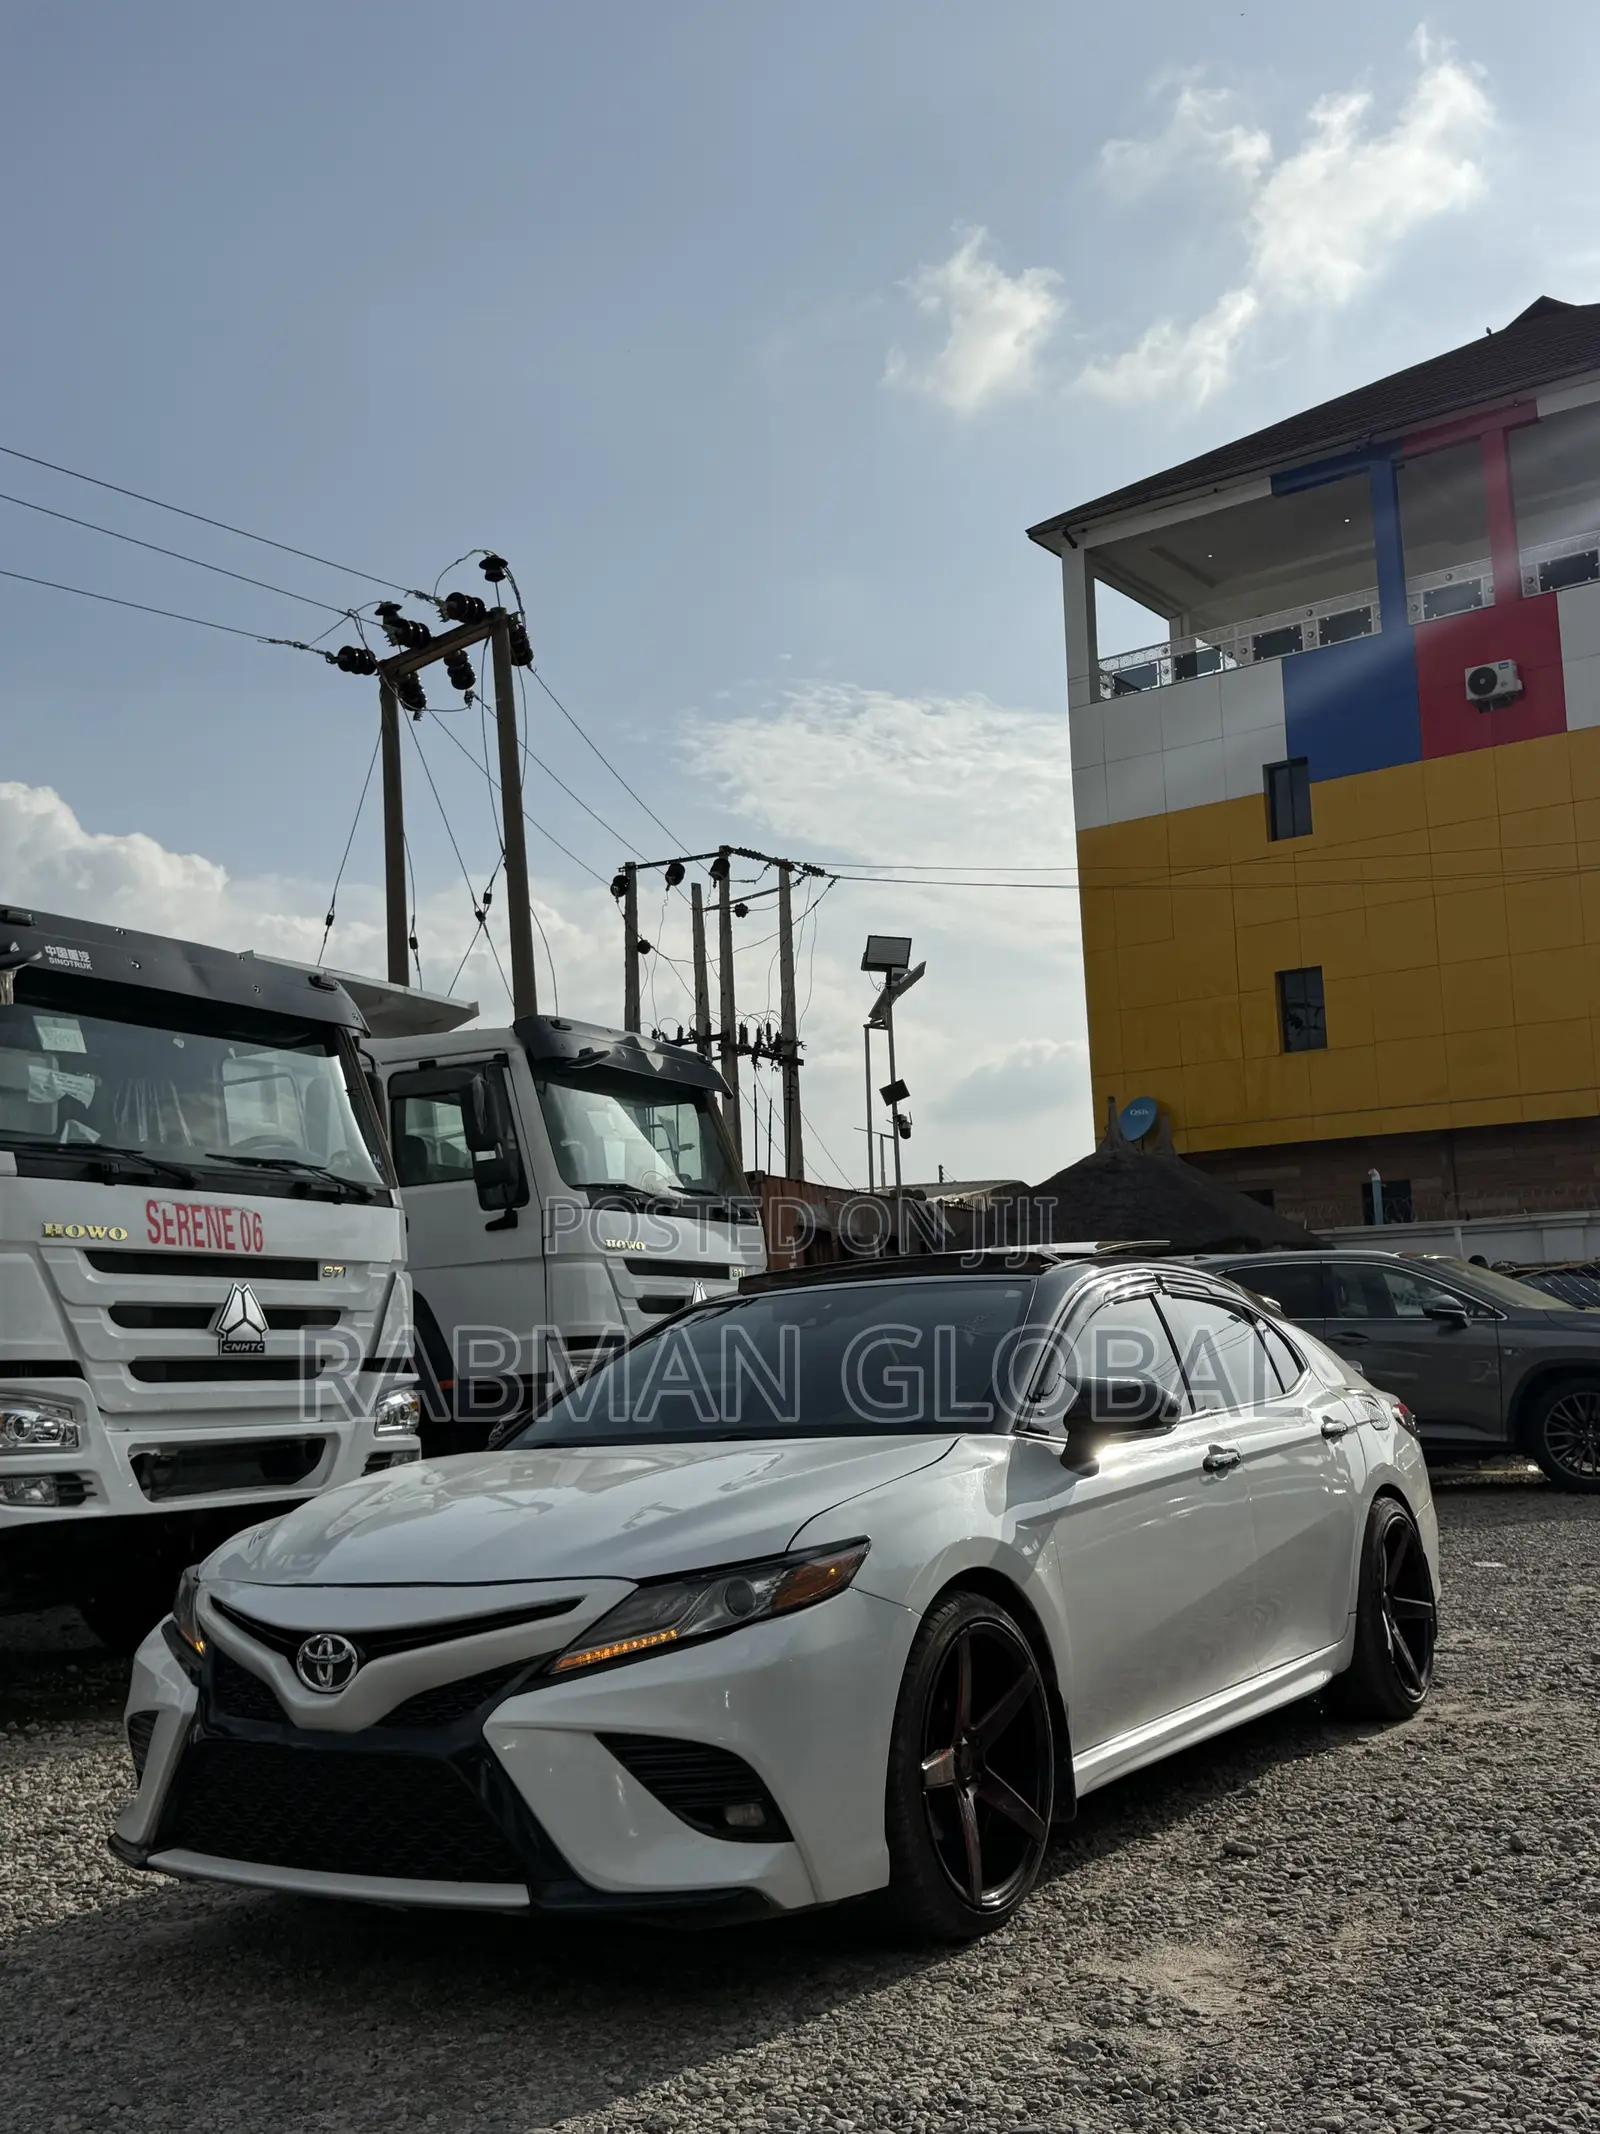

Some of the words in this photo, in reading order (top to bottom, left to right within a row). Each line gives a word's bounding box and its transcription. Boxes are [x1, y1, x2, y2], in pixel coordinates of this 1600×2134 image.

[48, 956, 93, 970] SINOTRUK
[42, 1221, 128, 1241] HOWO
[239, 1209, 264, 1252] 06
[223, 1342, 264, 1352] CNHTC
